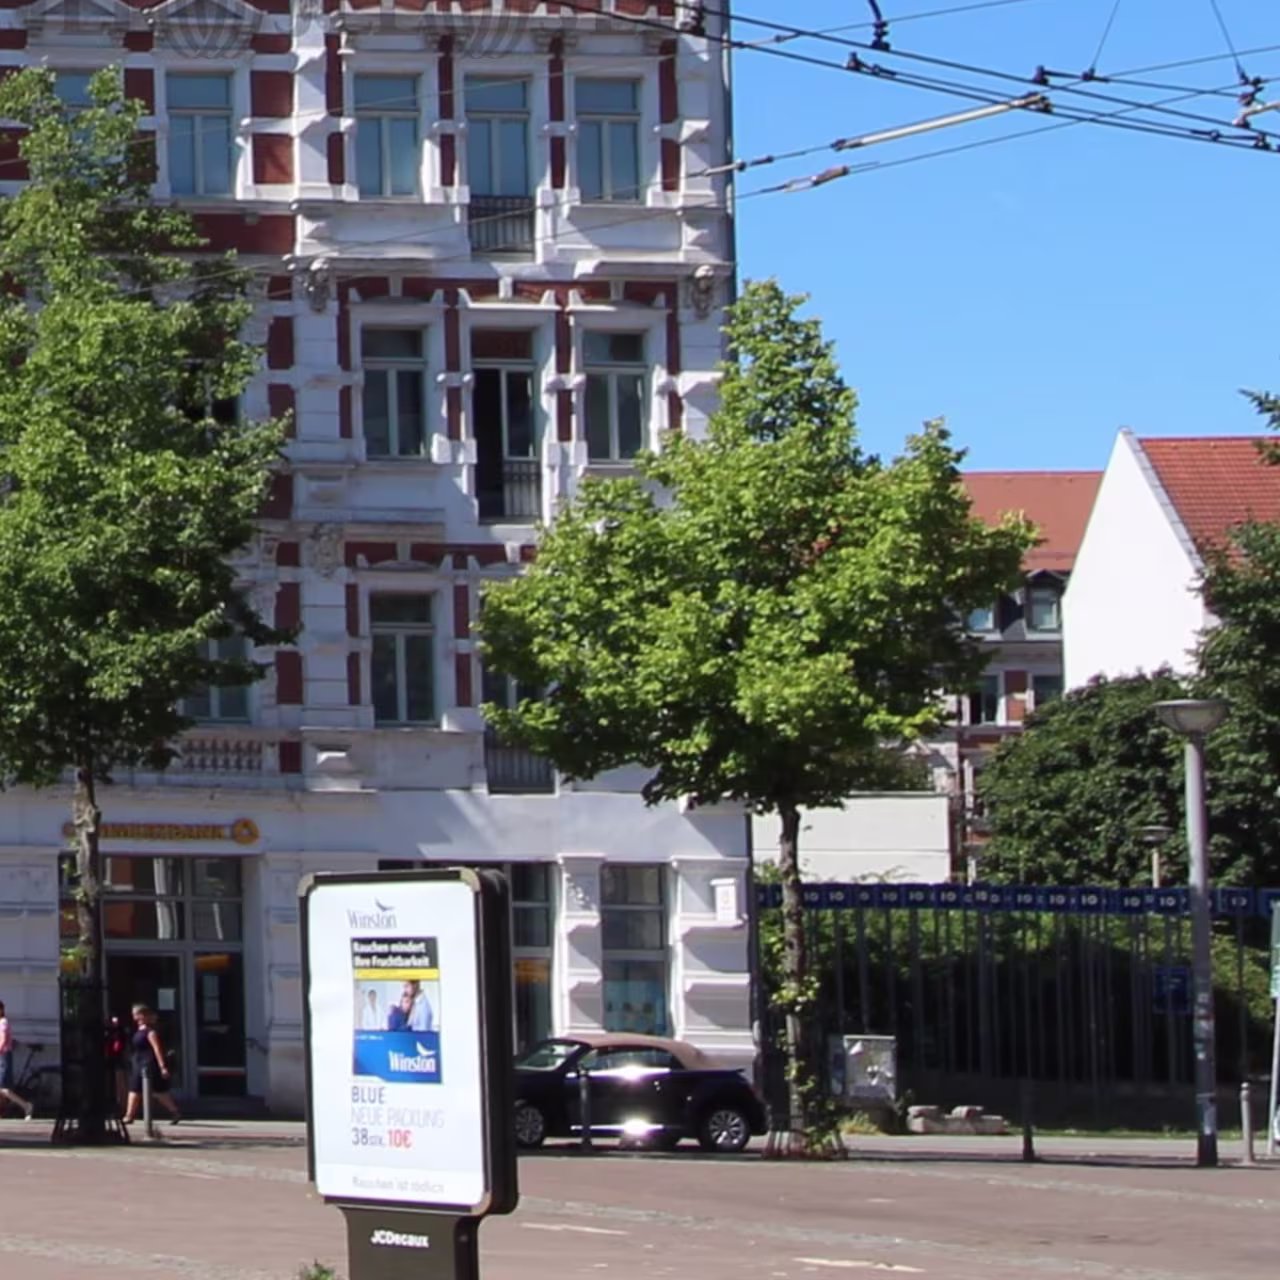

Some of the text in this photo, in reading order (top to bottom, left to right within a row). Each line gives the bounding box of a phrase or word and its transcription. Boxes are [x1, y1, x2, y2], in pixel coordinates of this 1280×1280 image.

[347, 909, 397, 929] Winston
[388, 1049, 437, 1072] Winston
[351, 1086, 386, 1104] BLUE
[351, 1106, 383, 1126] NEUE
[387, 1128, 413, 1148] 10€
[370, 1229, 430, 1249] JCDecaux
